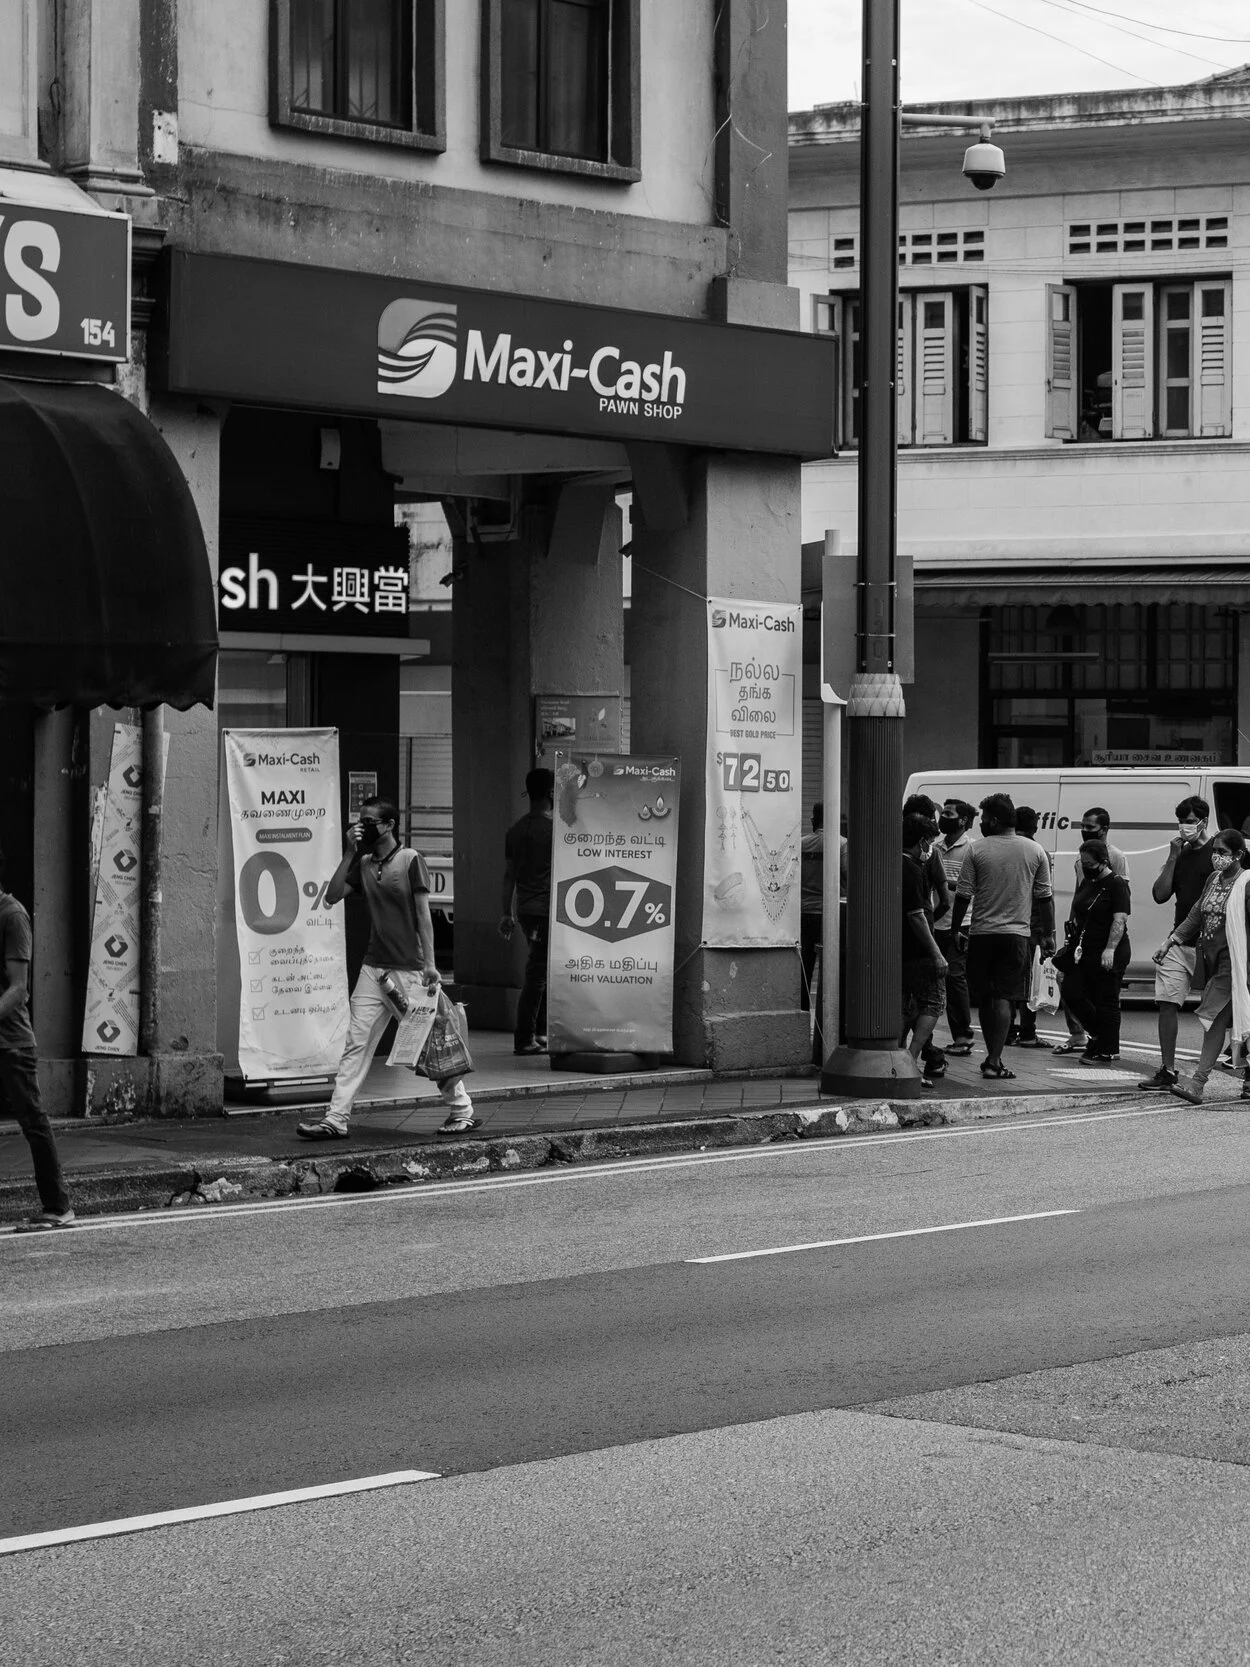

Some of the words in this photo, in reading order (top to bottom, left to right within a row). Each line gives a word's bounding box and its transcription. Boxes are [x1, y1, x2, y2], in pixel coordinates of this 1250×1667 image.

[0, 215, 61, 342] S
[80, 317, 116, 348] 154
[463, 329, 687, 404] Maxi-Cash
[599, 398, 639, 416] PAWN
[643, 402, 683, 419] SHOP
[290, 563, 409, 614] 大興當
[728, 612, 795, 633] Maxi-Cash
[729, 656, 780, 683] நல்ல
[737, 682, 772, 704] தங்க
[731, 705, 776, 724] விலை
[729, 729, 745, 738] BEST
[745, 730, 760, 739] GOLD
[760, 730, 777, 740] PRICE
[258, 752, 320, 767] Maxi-Cash
[625, 765, 676, 777] Maxi-Cash
[260, 789, 306, 805] MAXI
[1036, 811, 1070, 830] ffic
[563, 831, 626, 846] குறைந்த
[630, 832, 667, 848] வட்டி
[577, 848, 602, 858] LOW
[604, 848, 652, 860] INTEREST
[564, 879, 666, 929] 0.7%
[564, 955, 605, 971] அதிக
[609, 956, 658, 974] மதிப்பு
[570, 973, 594, 984] HIGH
[597, 974, 653, 985] VALUATION
